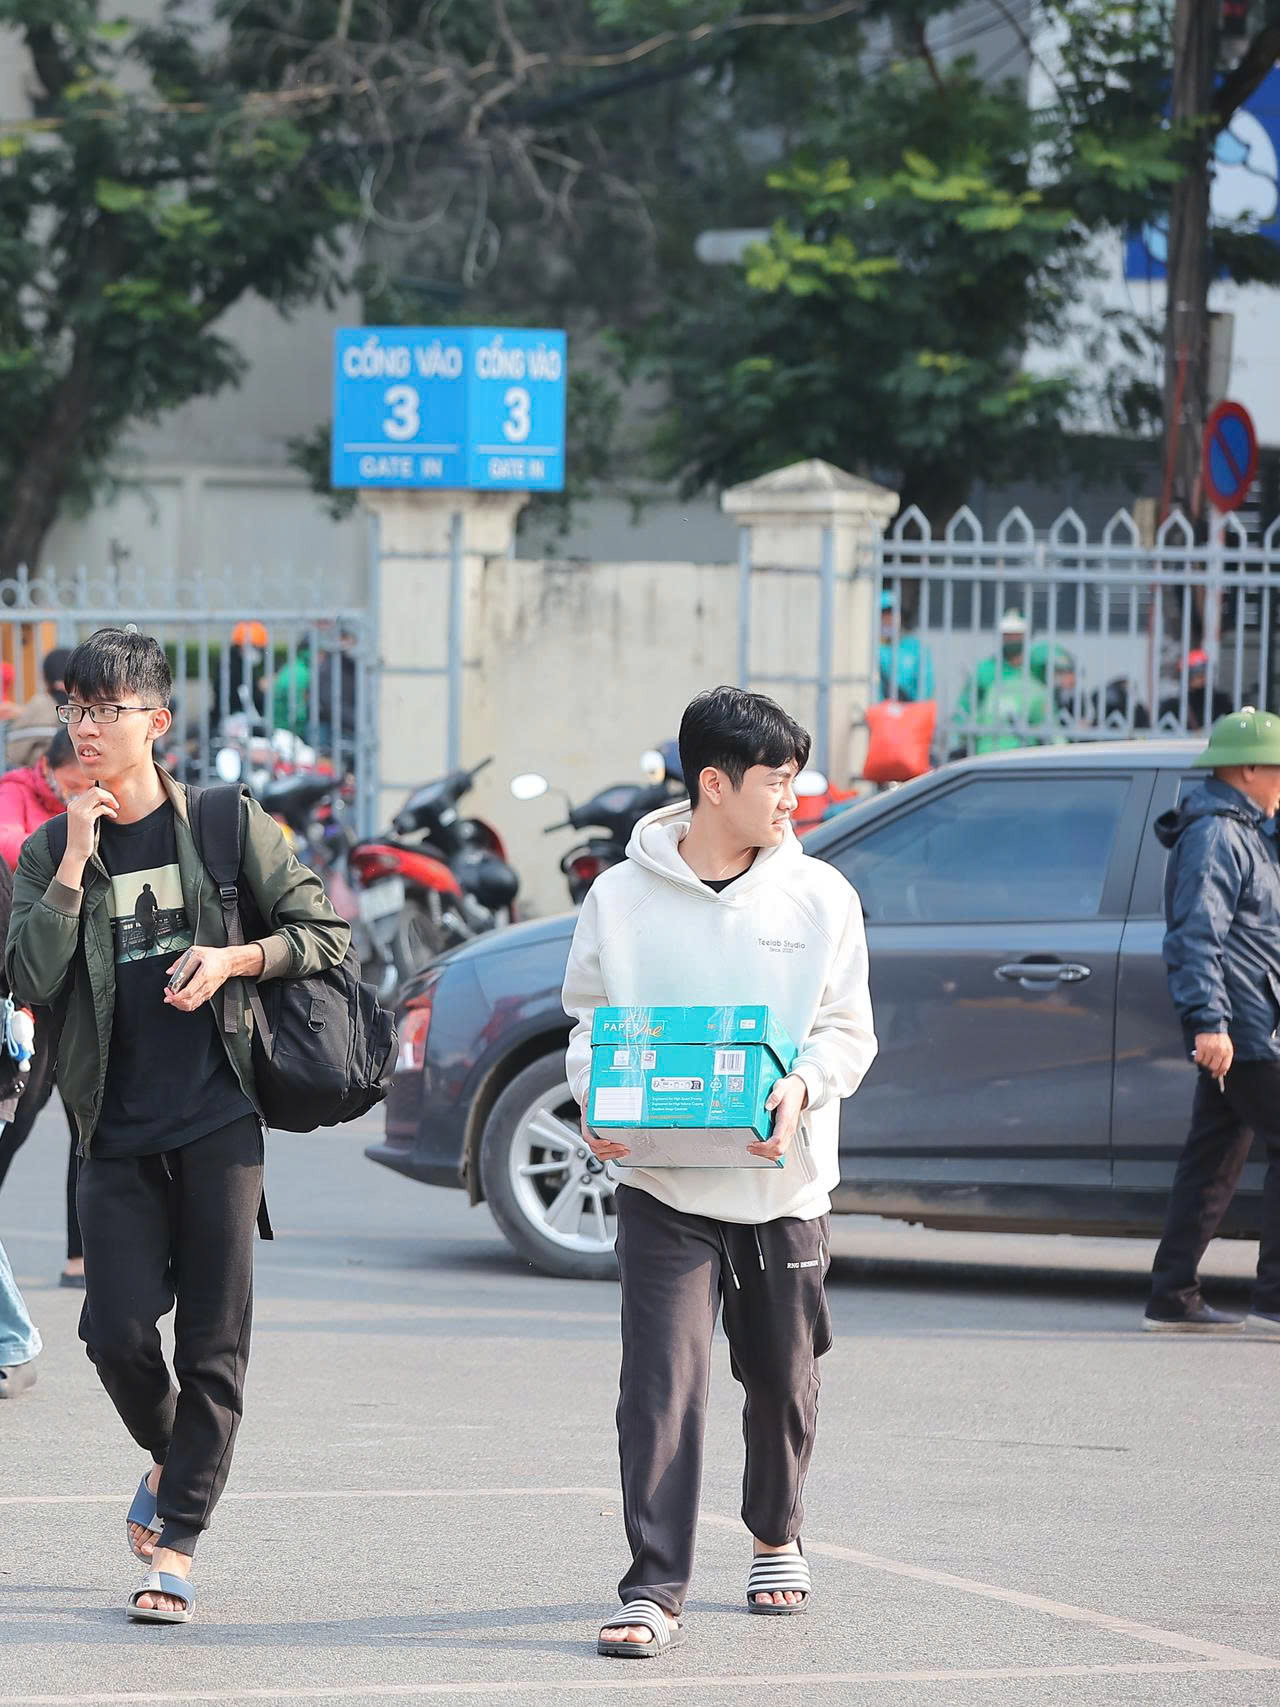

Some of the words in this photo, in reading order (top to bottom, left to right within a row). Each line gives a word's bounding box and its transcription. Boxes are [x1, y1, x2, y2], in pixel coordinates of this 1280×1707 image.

[383, 384, 420, 441] 3
[503, 386, 531, 443] 3
[359, 456, 413, 478] GATE
[421, 457, 443, 479] IN
[488, 457, 524, 479] GATE
[529, 458, 545, 480] IN
[784, 940, 806, 949] Studio
[603, 1022, 639, 1032] PAPER
